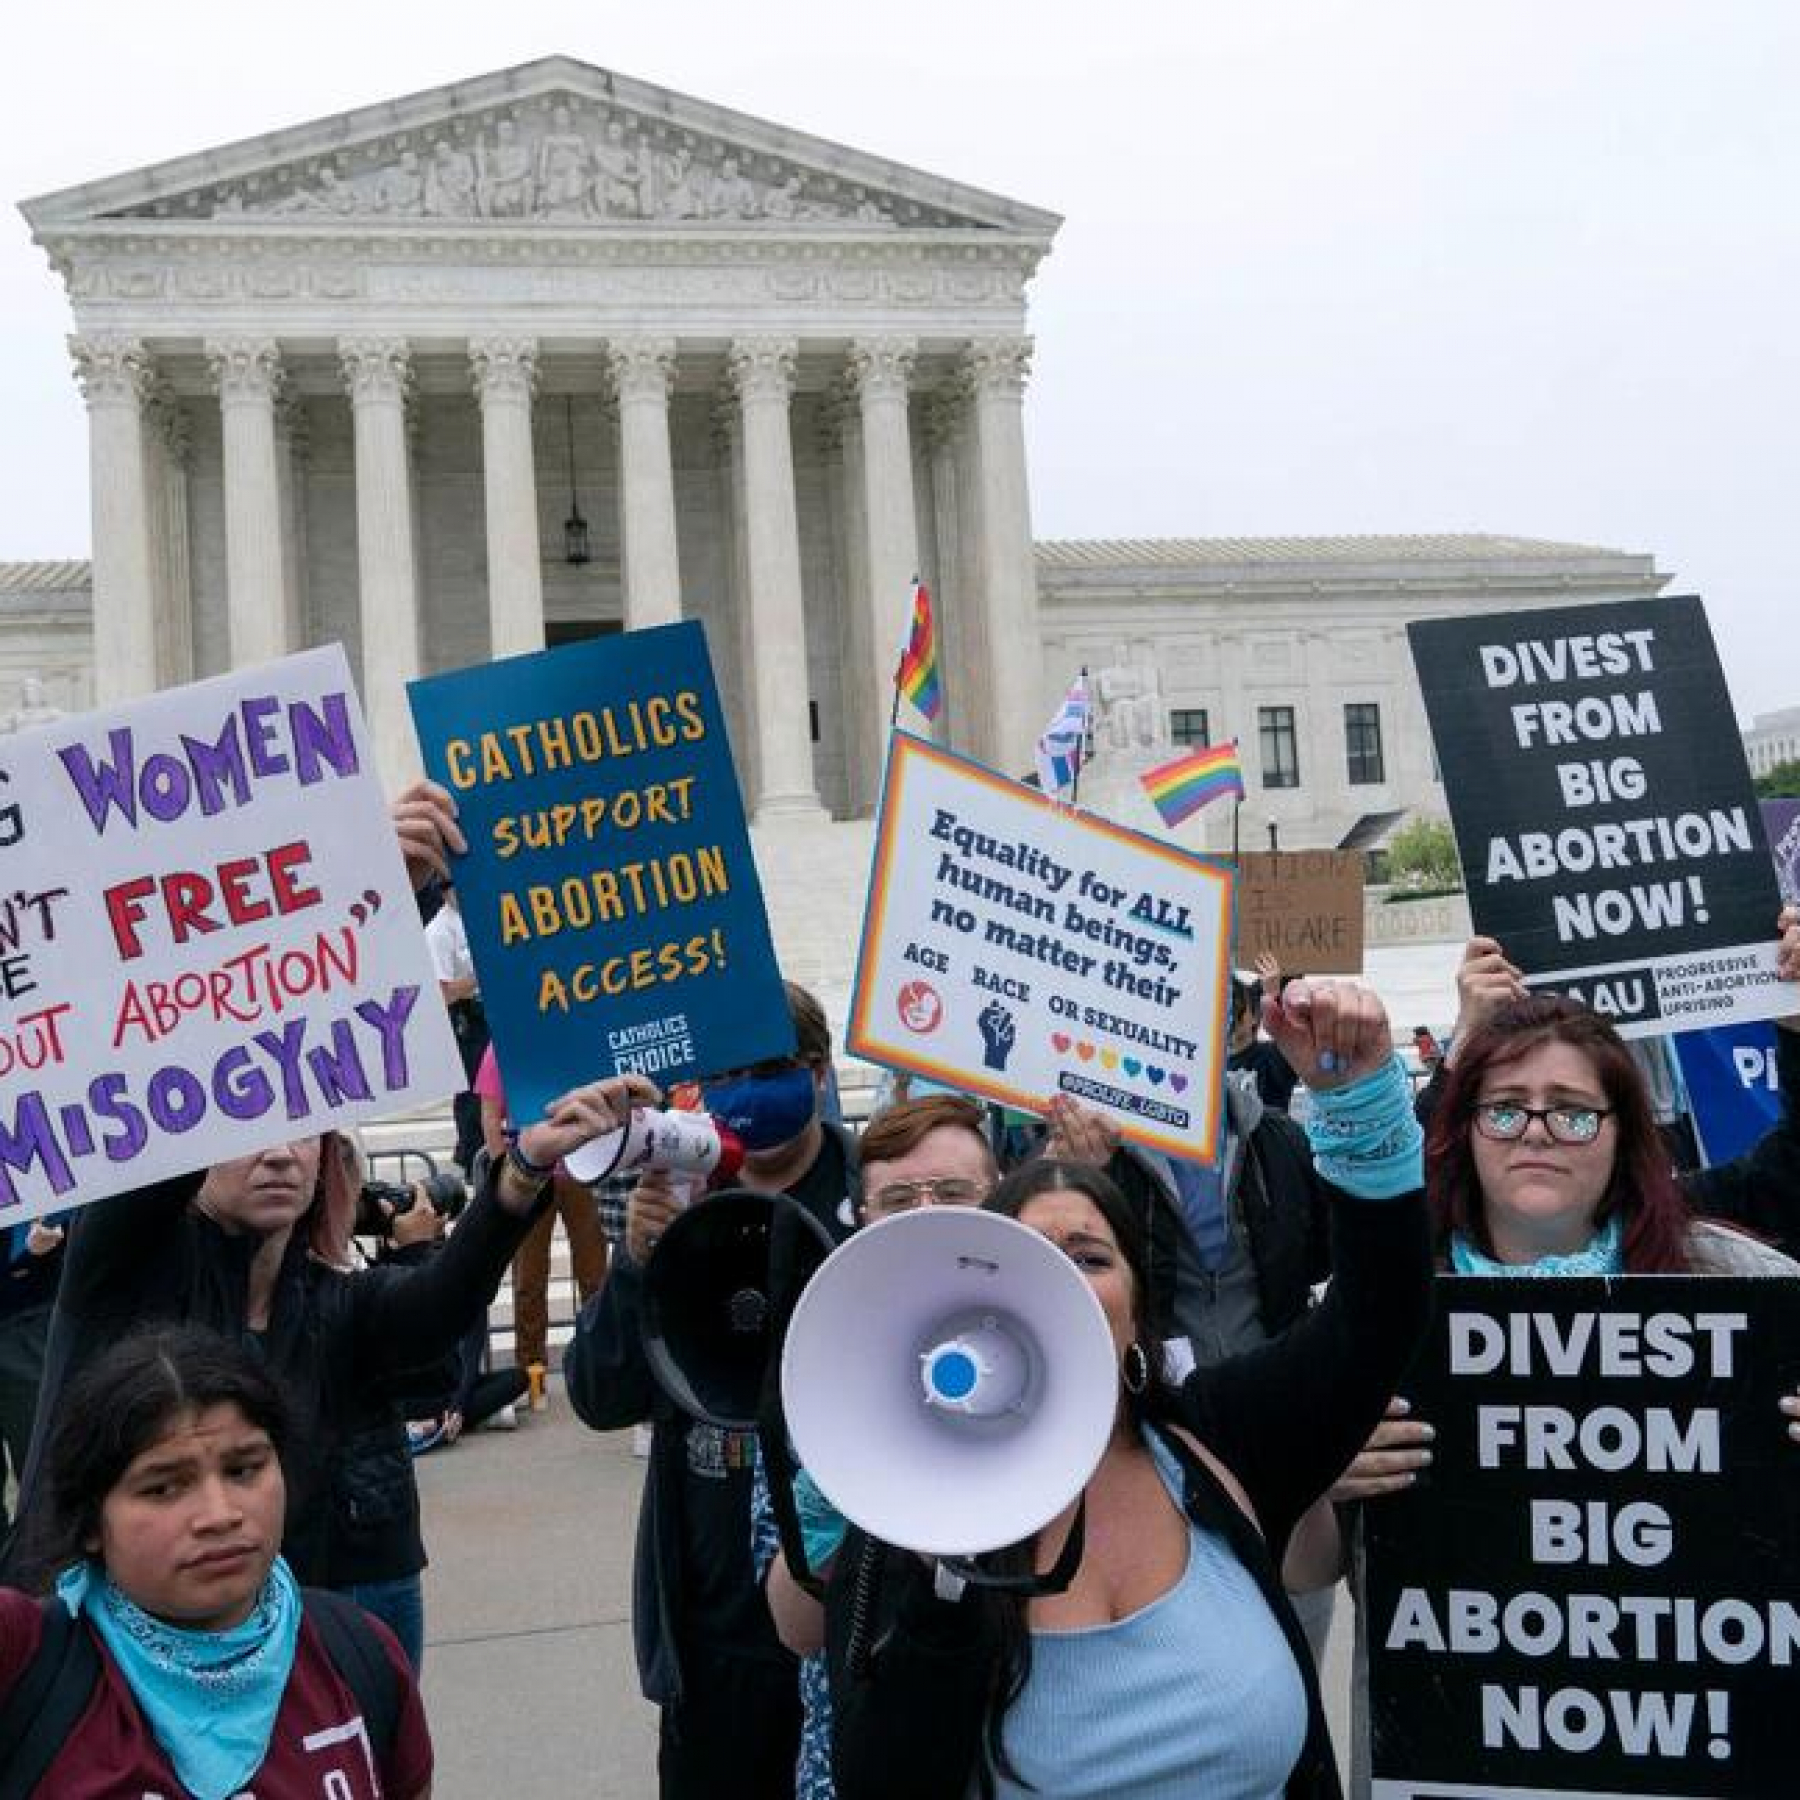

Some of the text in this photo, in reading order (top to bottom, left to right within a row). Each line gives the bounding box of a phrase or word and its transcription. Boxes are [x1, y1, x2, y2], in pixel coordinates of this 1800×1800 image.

[1480, 629, 1655, 688] DIVEST
[446, 691, 705, 790] CATHOLICS
[1511, 690, 1662, 748] FROM
[56, 692, 360, 836] WOMEN
[1556, 757, 1647, 808] BIG
[493, 778, 696, 858] SUPPORT
[1487, 806, 1754, 883] ABORTION
[103, 840, 322, 960] FREE
[500, 845, 729, 945] ABORTION
[929, 809, 1194, 938] Equality for ALL
[1552, 876, 1709, 942] NOW!
[936, 853, 1178, 972] human beings,
[538, 929, 726, 1013] ACCESS!
[931, 899, 1181, 1007] no matter their
[1655, 954, 1758, 981] PROGRESSIVE
[608, 1013, 688, 1050] CATHOLICS
[903, 942, 1197, 1060] AGE RACE OR SEXUALITY
[1448, 1313, 1748, 1378] DIVEST
[1477, 1406, 1721, 1473] FROM
[1530, 1500, 1673, 1567] BIG
[1385, 1588, 1800, 1666] ABORTION
[1482, 1685, 1731, 1761] NOW!
